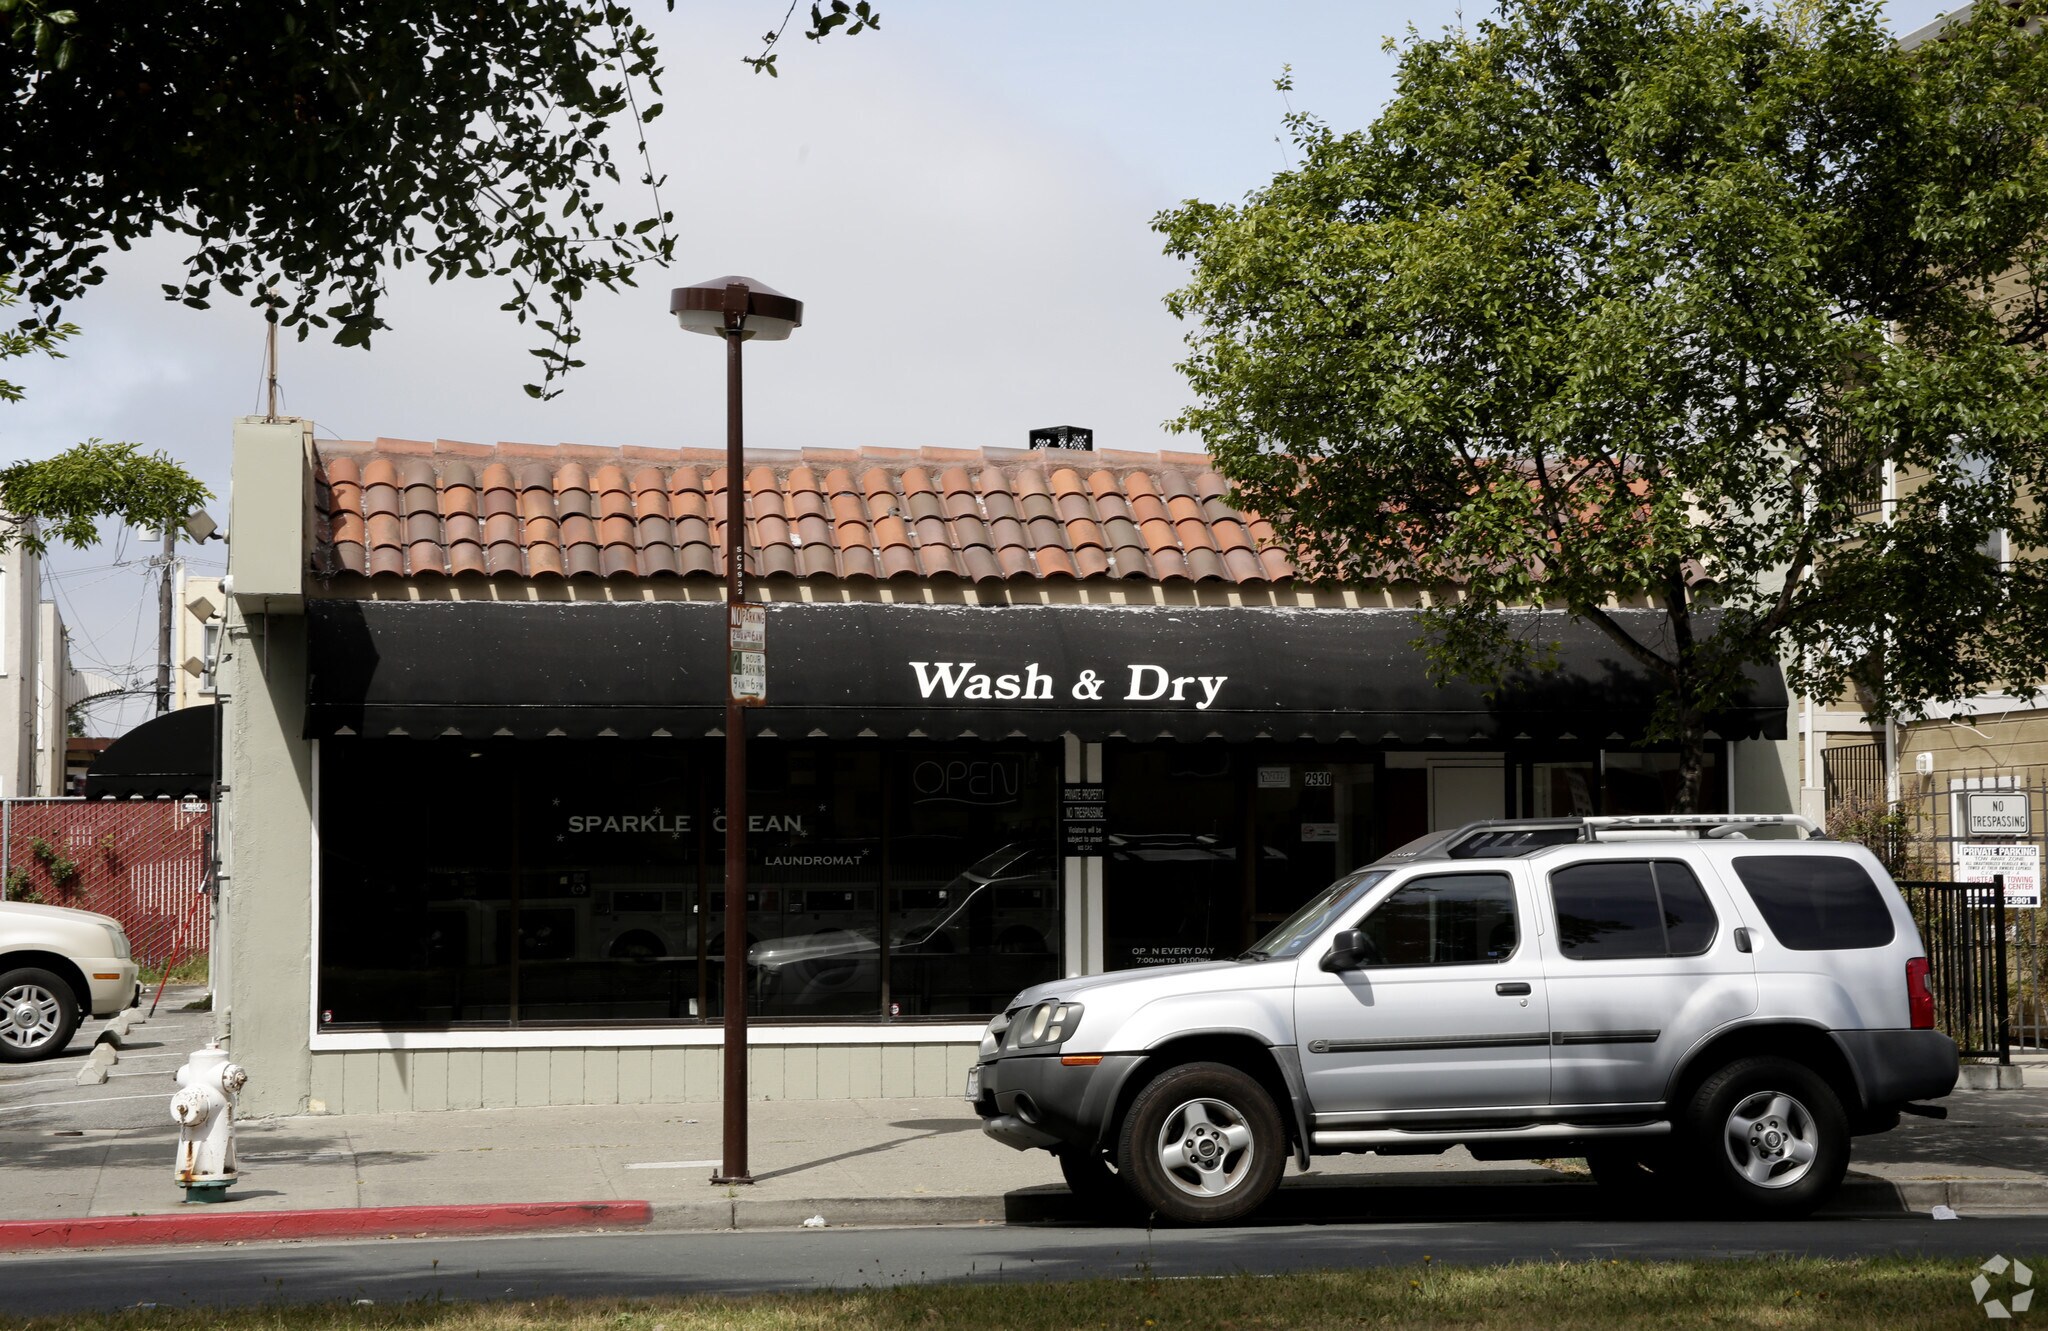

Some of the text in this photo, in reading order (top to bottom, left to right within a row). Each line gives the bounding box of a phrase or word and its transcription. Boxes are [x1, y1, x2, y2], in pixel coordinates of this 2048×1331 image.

[731, 606, 765, 625] NO PARKING
[746, 654, 761, 663] HOUR
[742, 663, 765, 677] PARKING
[909, 661, 1228, 710] Wash & Dry
[913, 761, 1019, 796] OPEN
[1305, 772, 1331, 786] 2930
[1064, 788, 1105, 800] PRIVATE PROPERTY
[1065, 806, 1104, 818] NO TRESPASSING
[1993, 801, 2004, 812] NO
[568, 815, 801, 833] SPARKLE CEAN
[1972, 815, 2025, 828] TRESPASSING
[1963, 847, 2036, 856] PRIVATE PARKING
[765, 856, 863, 866] LAUNDROMAT
[1132, 947, 1215, 955] OPN EVERY DAY
